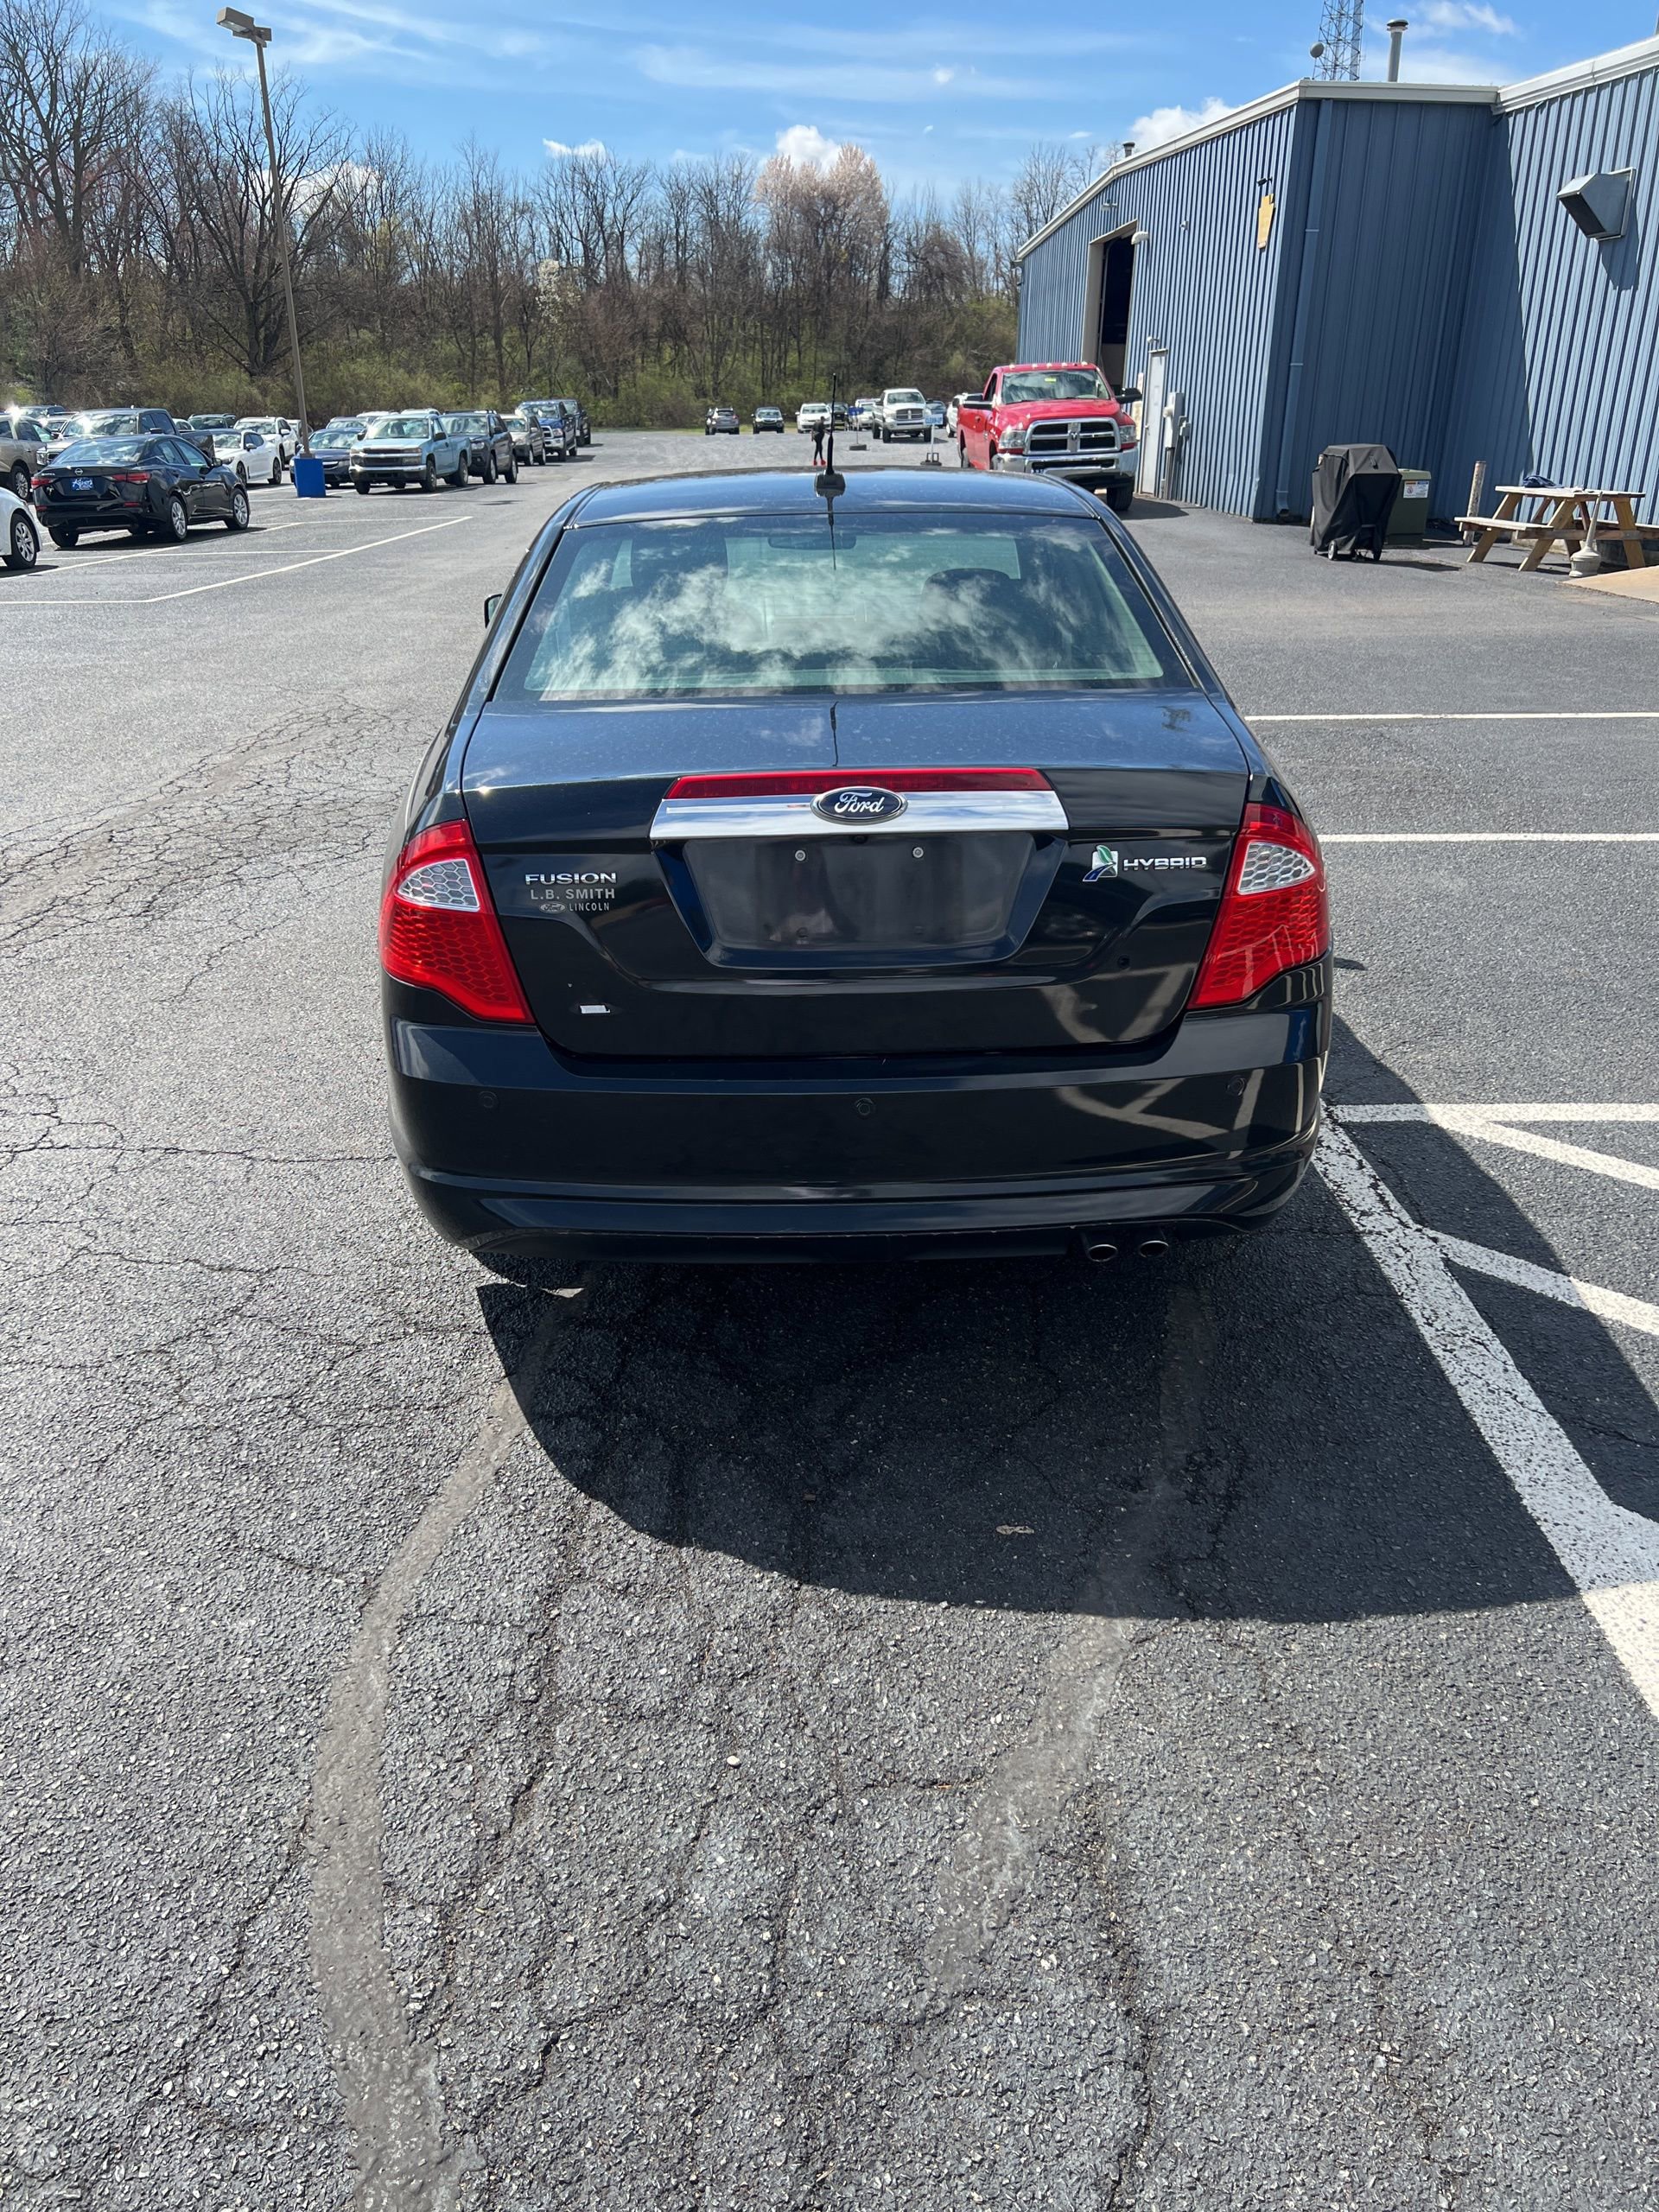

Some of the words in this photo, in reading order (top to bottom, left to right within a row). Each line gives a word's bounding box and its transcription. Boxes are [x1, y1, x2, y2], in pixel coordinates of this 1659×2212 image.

[834, 791, 885, 813] Ford
[1123, 856, 1207, 871] HYBRID
[525, 872, 617, 885] FUSION
[531, 889, 560, 900] L.B.
[565, 888, 615, 899] SMITH
[569, 902, 610, 912] LINCOLN
